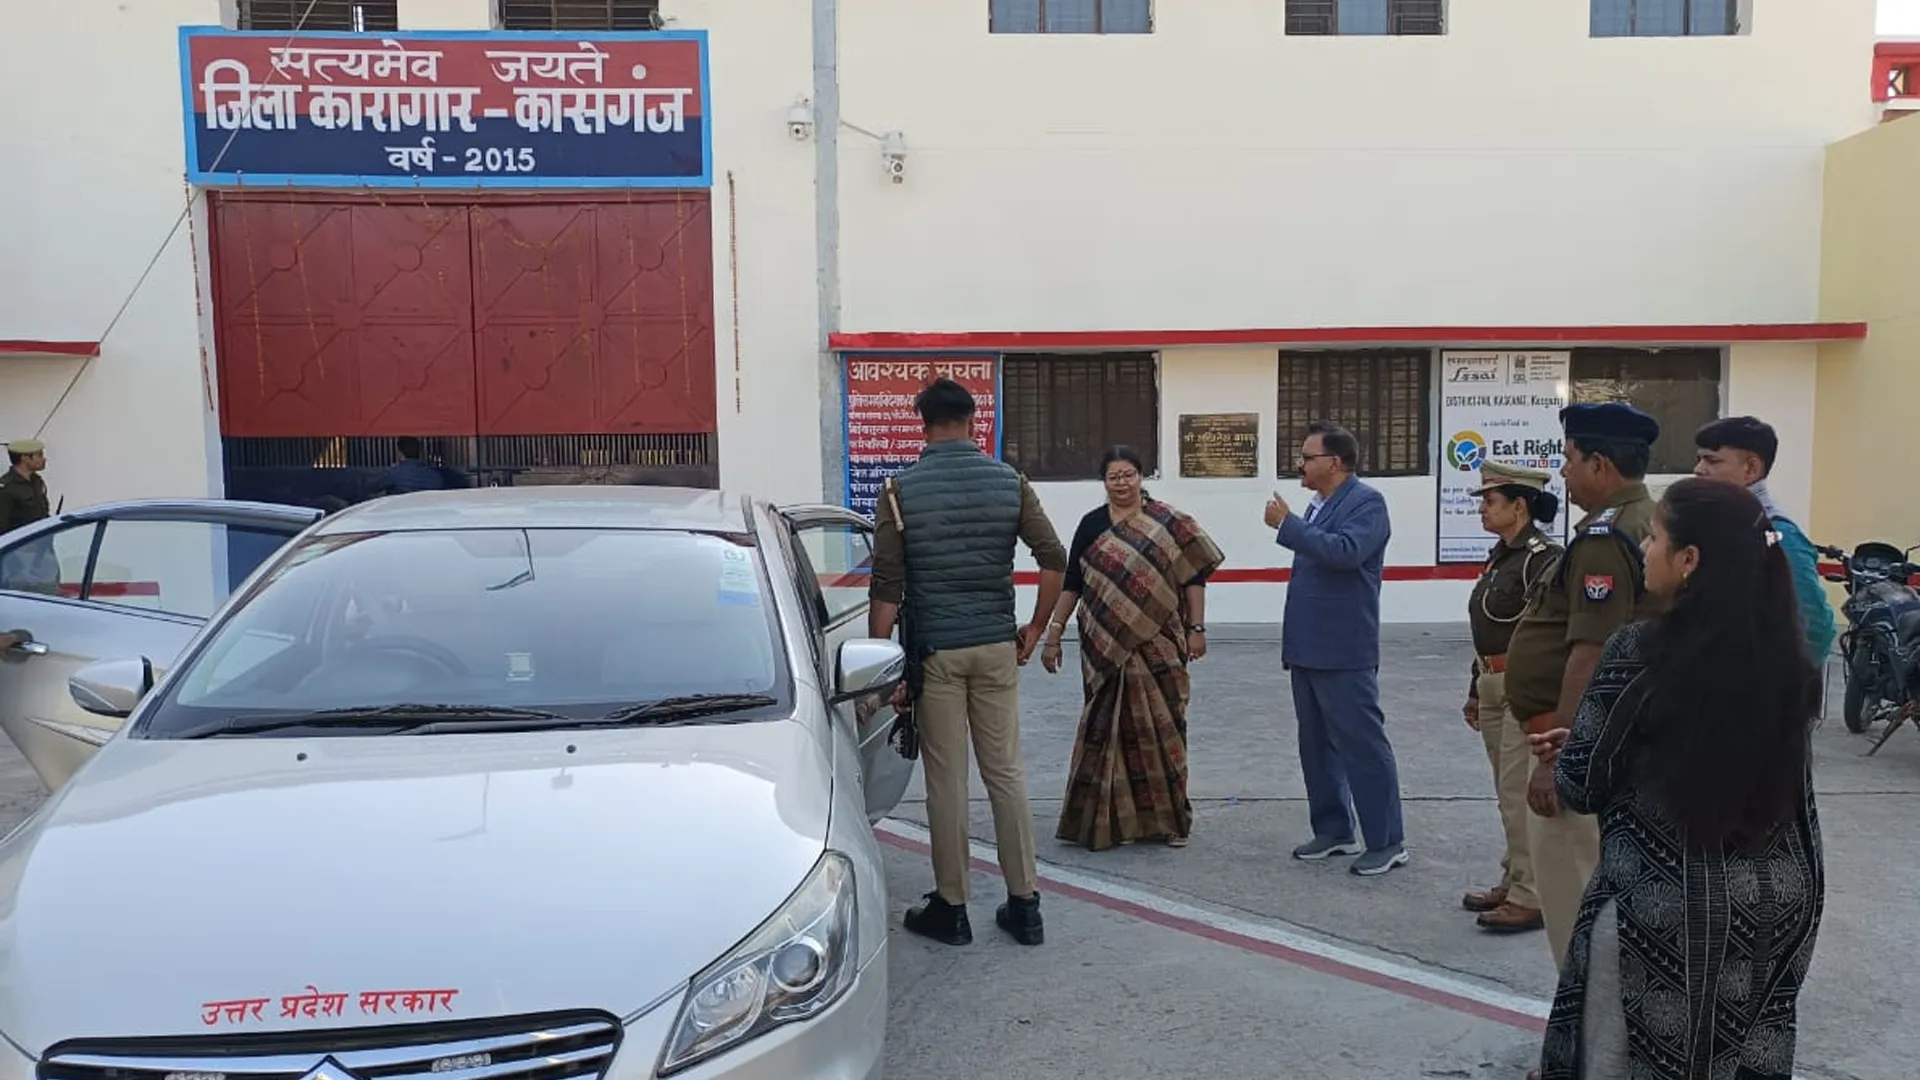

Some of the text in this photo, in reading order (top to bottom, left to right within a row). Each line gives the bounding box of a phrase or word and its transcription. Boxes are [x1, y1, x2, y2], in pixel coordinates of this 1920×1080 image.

[270, 39, 609, 84] सत्यमेव जयते
[200, 58, 302, 130] जिला
[308, 85, 481, 132] कारागार
[513, 63, 693, 133] कासगंज
[385, 136, 436, 172] वर्ष
[465, 147, 535, 172] 2015
[849, 361, 993, 381] आवश्यक सचना
[1493, 439, 1562, 458] Eat Right
[202, 985, 459, 1025] उत्तर प्रदेश सरकार
